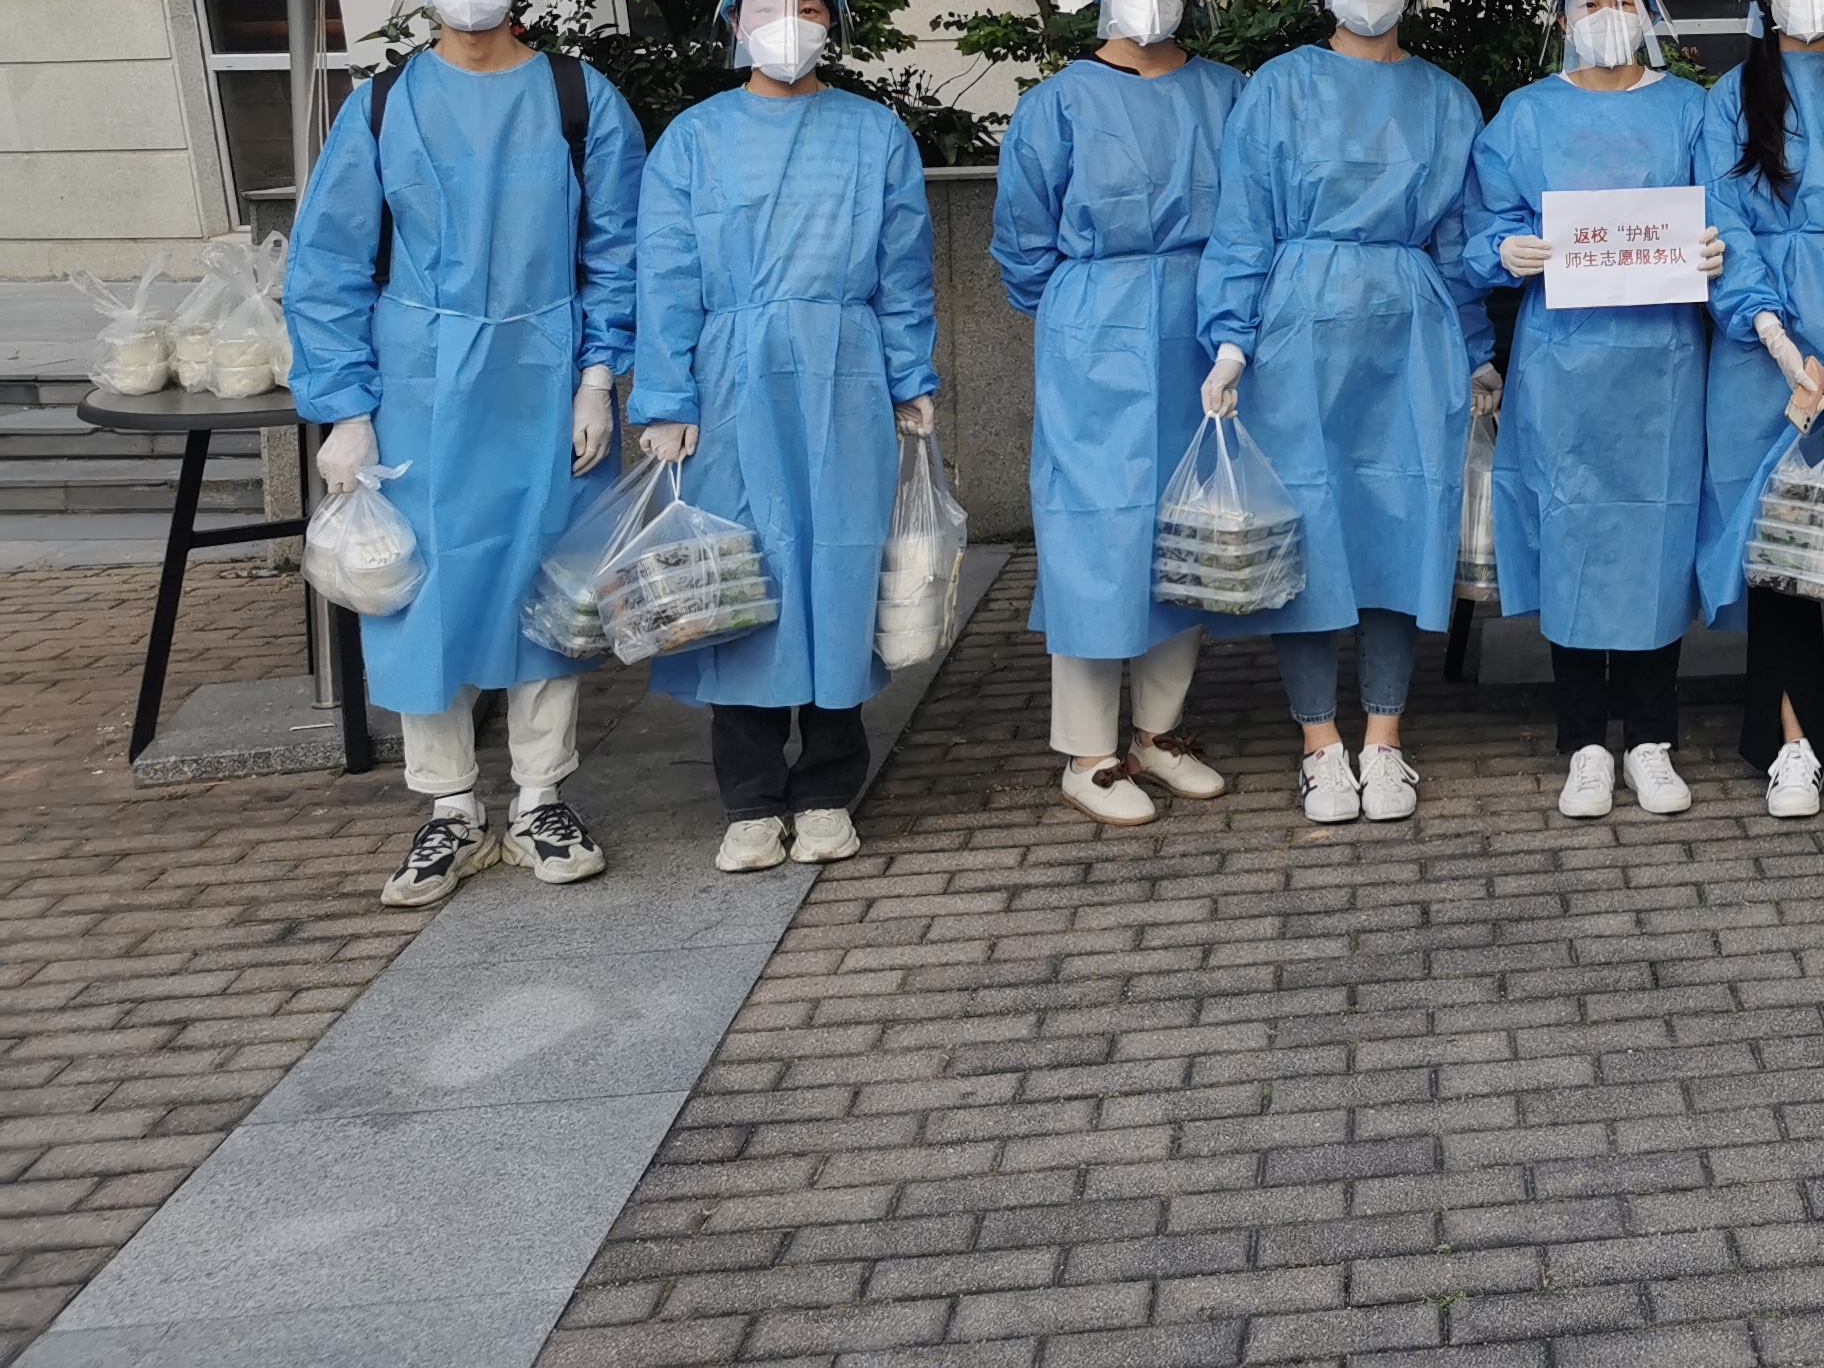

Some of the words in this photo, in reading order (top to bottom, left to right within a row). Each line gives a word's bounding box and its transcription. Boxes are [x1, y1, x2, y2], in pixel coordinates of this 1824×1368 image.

[1573, 223, 1670, 245] 返校“护航”
[1564, 246, 1687, 269] 师生志愿服务队
